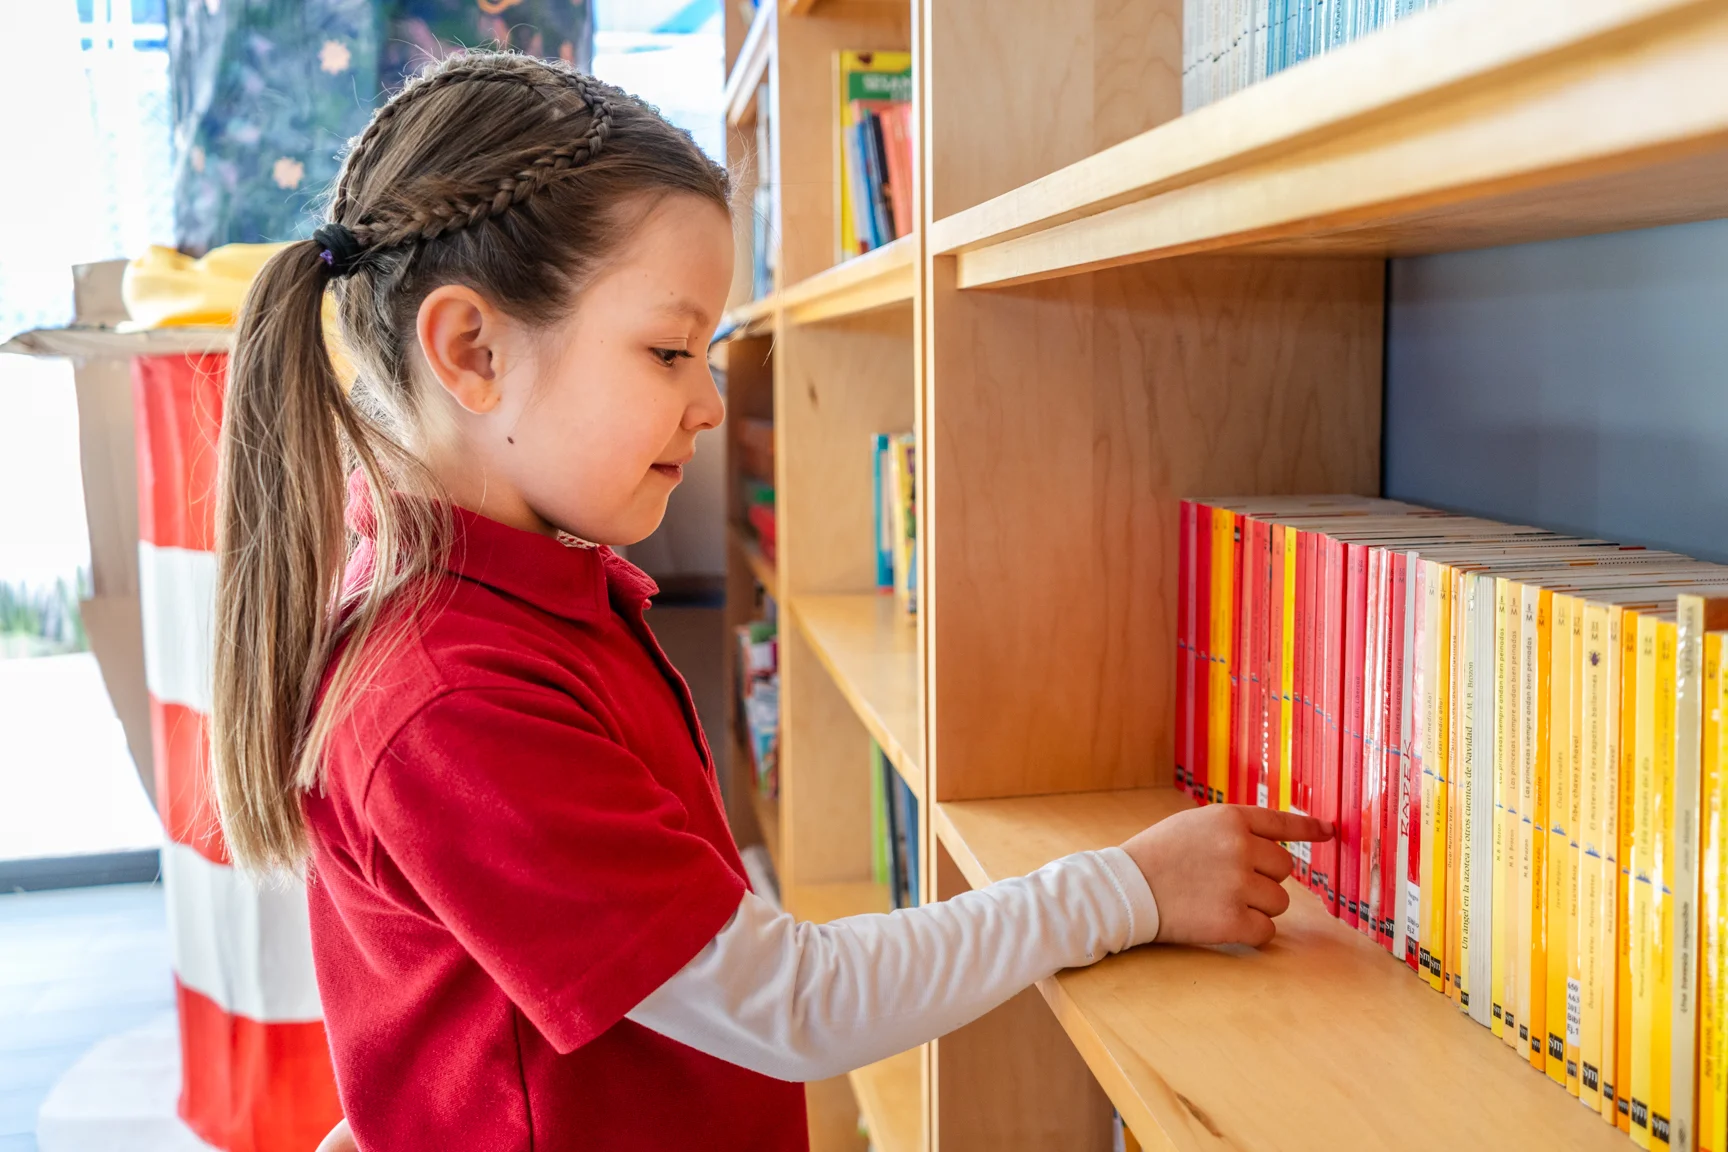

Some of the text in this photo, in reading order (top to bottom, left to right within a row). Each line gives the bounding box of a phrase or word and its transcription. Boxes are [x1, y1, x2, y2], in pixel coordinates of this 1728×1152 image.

[1526, 637, 1534, 672] peinadas
[1465, 727, 1473, 765] Navidad
[1464, 767, 1472, 779] de
[1524, 749, 1532, 784] princesas
[1590, 772, 1597, 782] de
[1464, 782, 1472, 816] cuentos
[1463, 853, 1471, 883] azotea
[1462, 884, 1470, 893] la
[1463, 896, 1470, 906] en
[1462, 910, 1470, 935] ángel
[1462, 937, 1469, 950] Un
